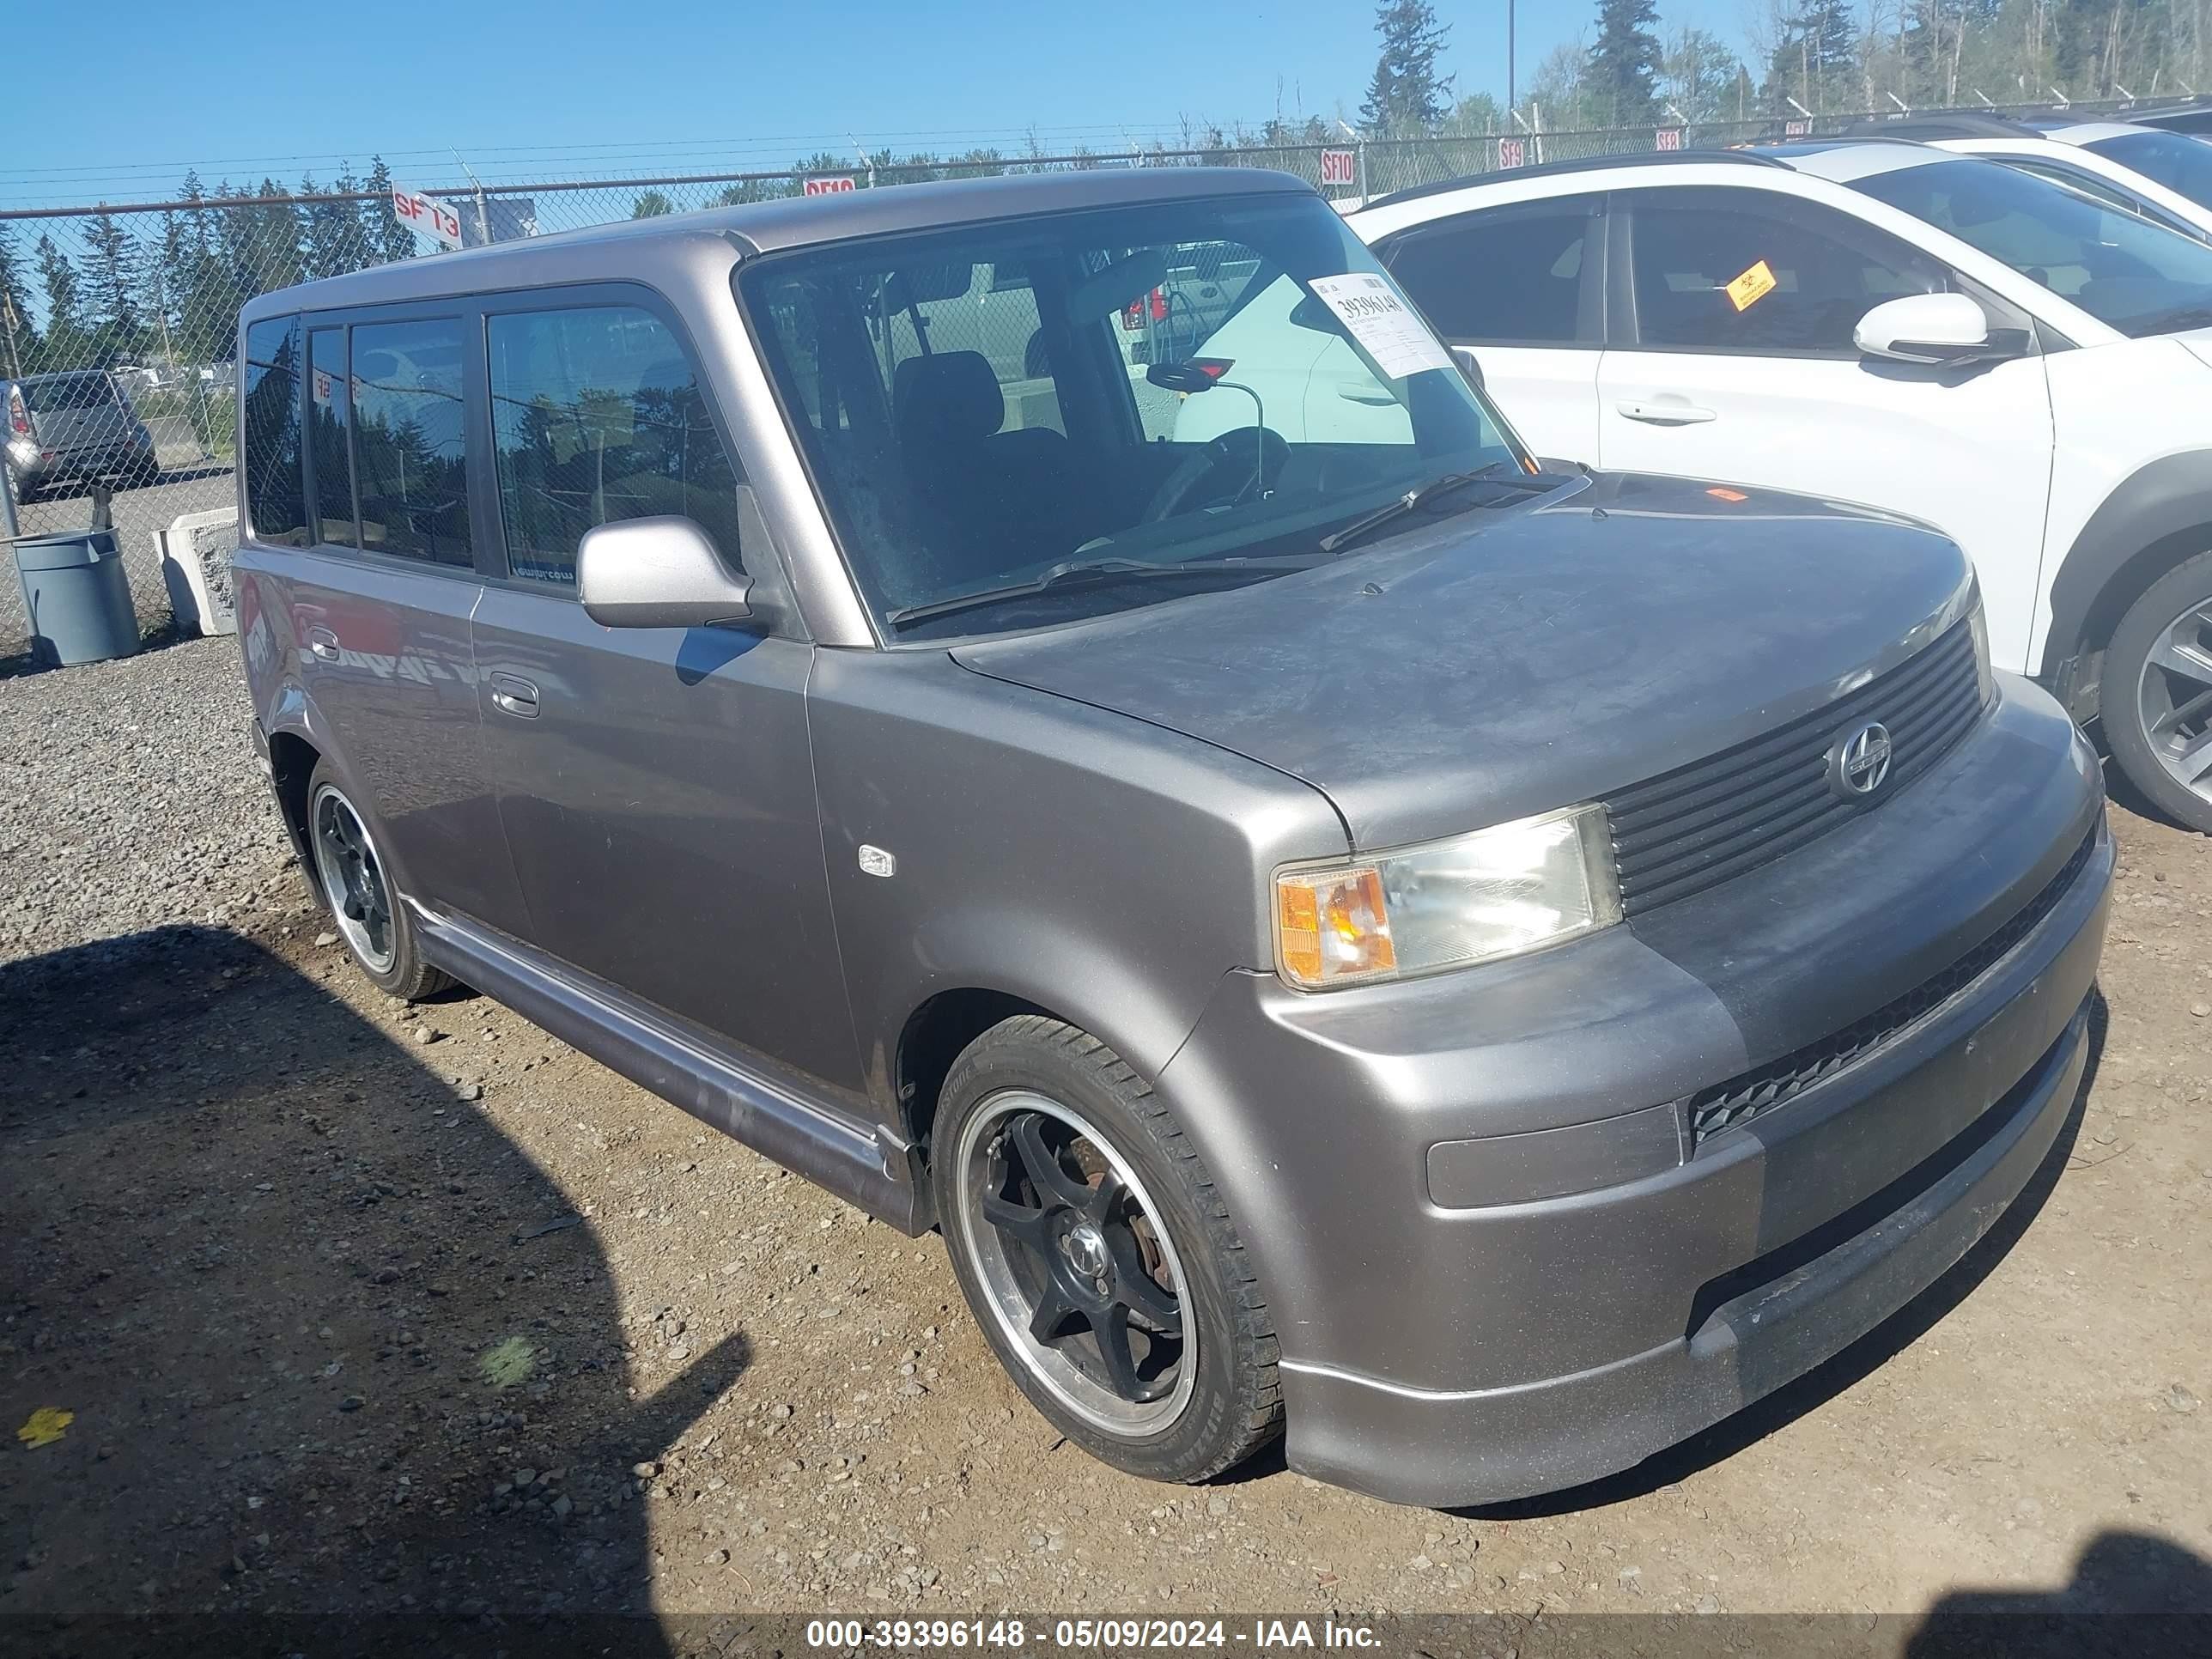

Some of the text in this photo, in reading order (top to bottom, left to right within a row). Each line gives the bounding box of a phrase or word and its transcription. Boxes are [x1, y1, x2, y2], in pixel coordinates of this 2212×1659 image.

[1322, 152, 1352, 180] SF10
[1501, 143, 1522, 167] SF9
[395, 192, 459, 237] SF 13
[1337, 295, 1403, 319] 39396148
